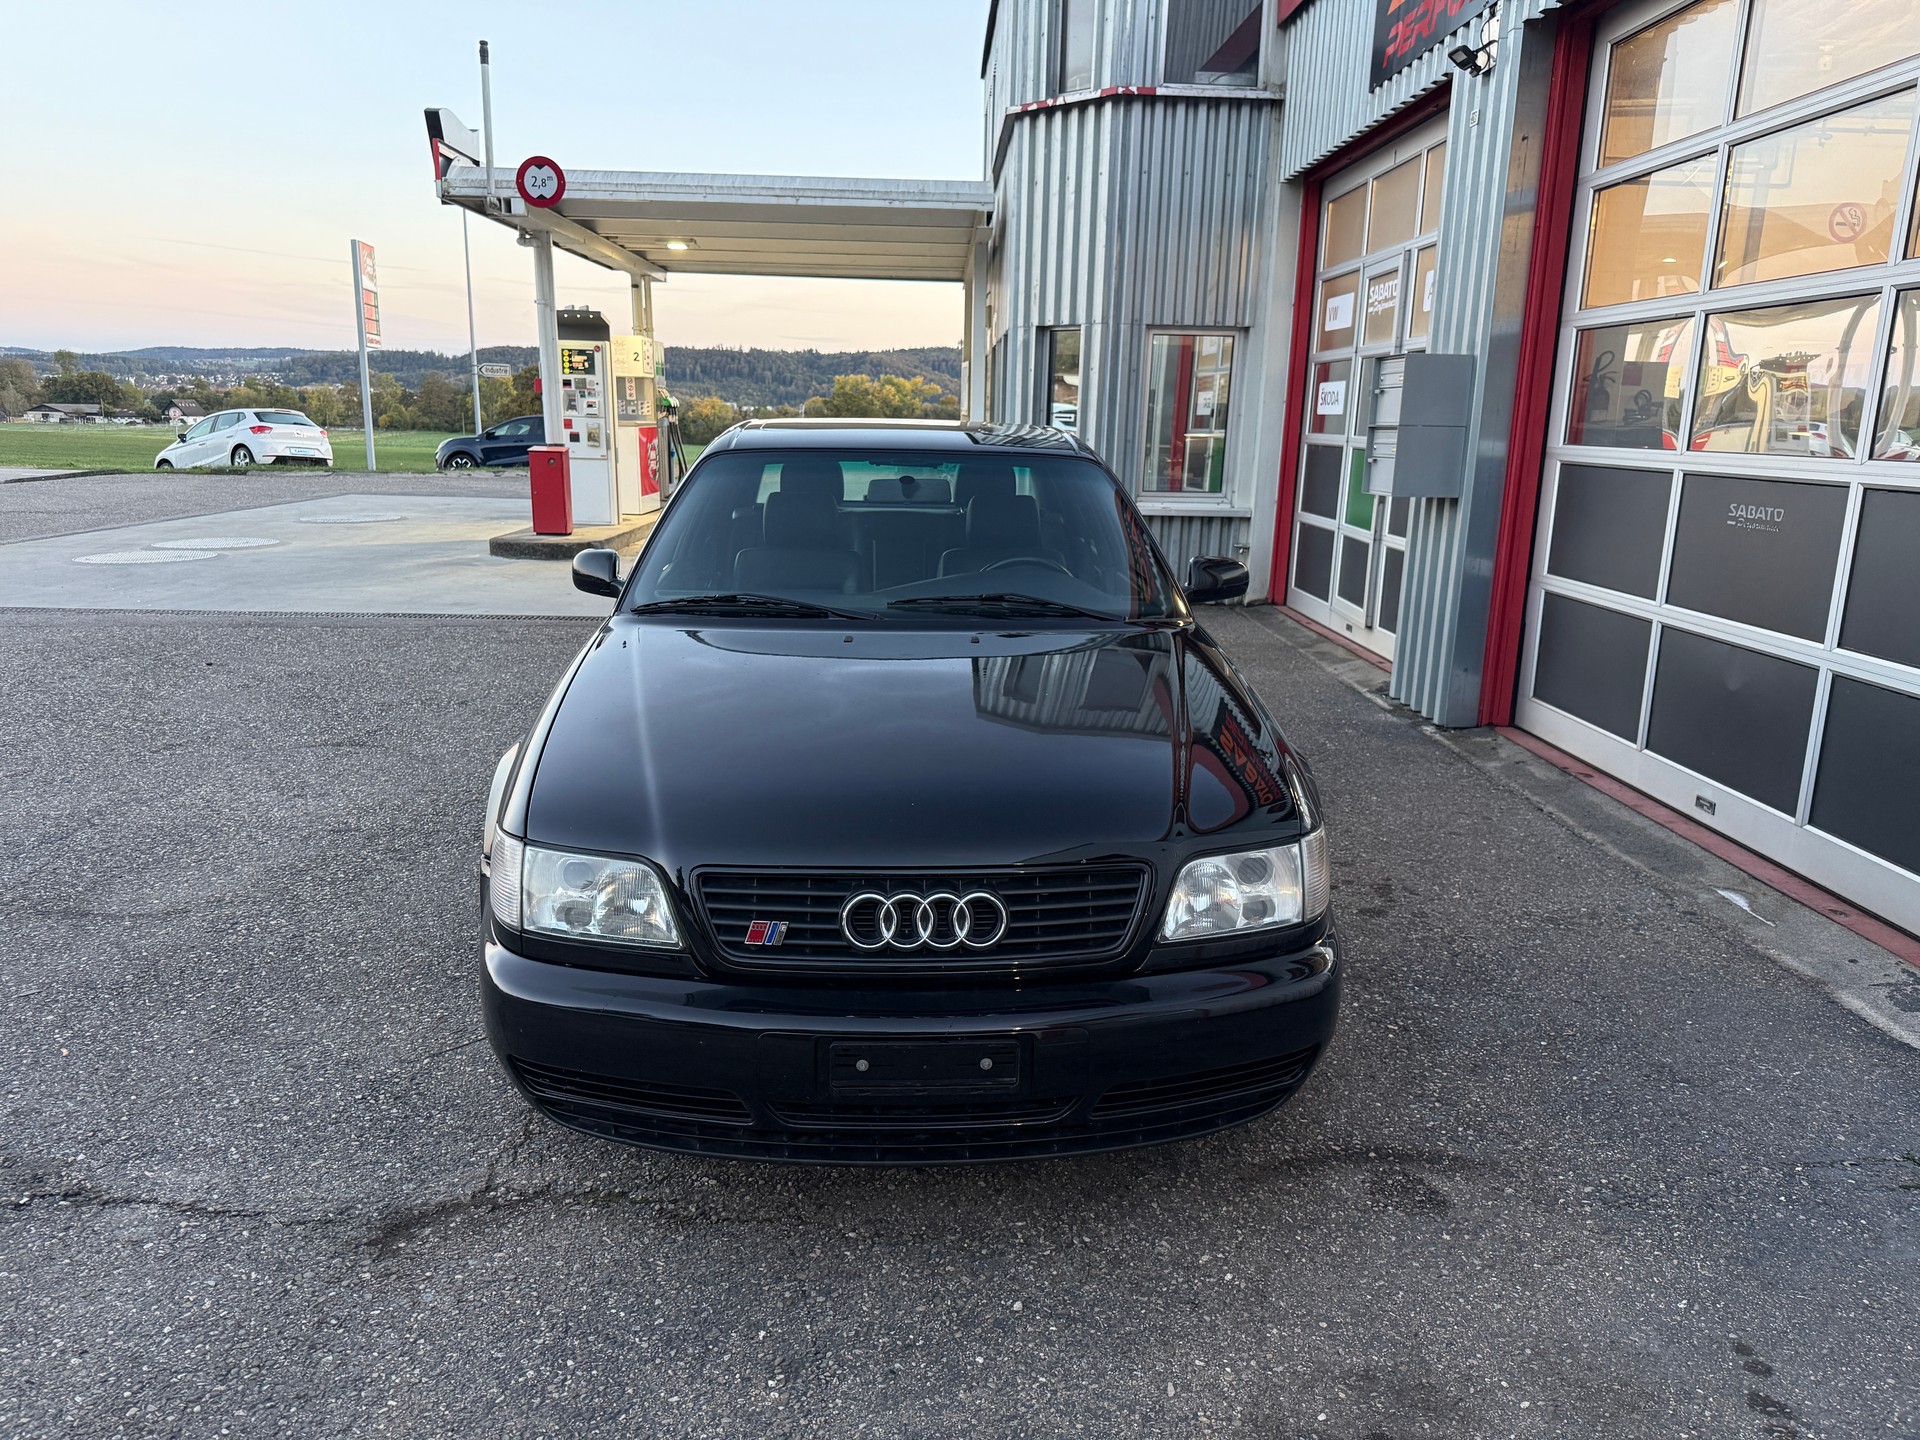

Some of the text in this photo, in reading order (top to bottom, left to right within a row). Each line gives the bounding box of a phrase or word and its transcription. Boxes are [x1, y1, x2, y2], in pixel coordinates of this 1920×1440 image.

[1383, 0, 1474, 69] PERF
[1328, 305, 1339, 322] VW
[633, 351, 640, 362] 2
[1728, 503, 1784, 521] SABATO
